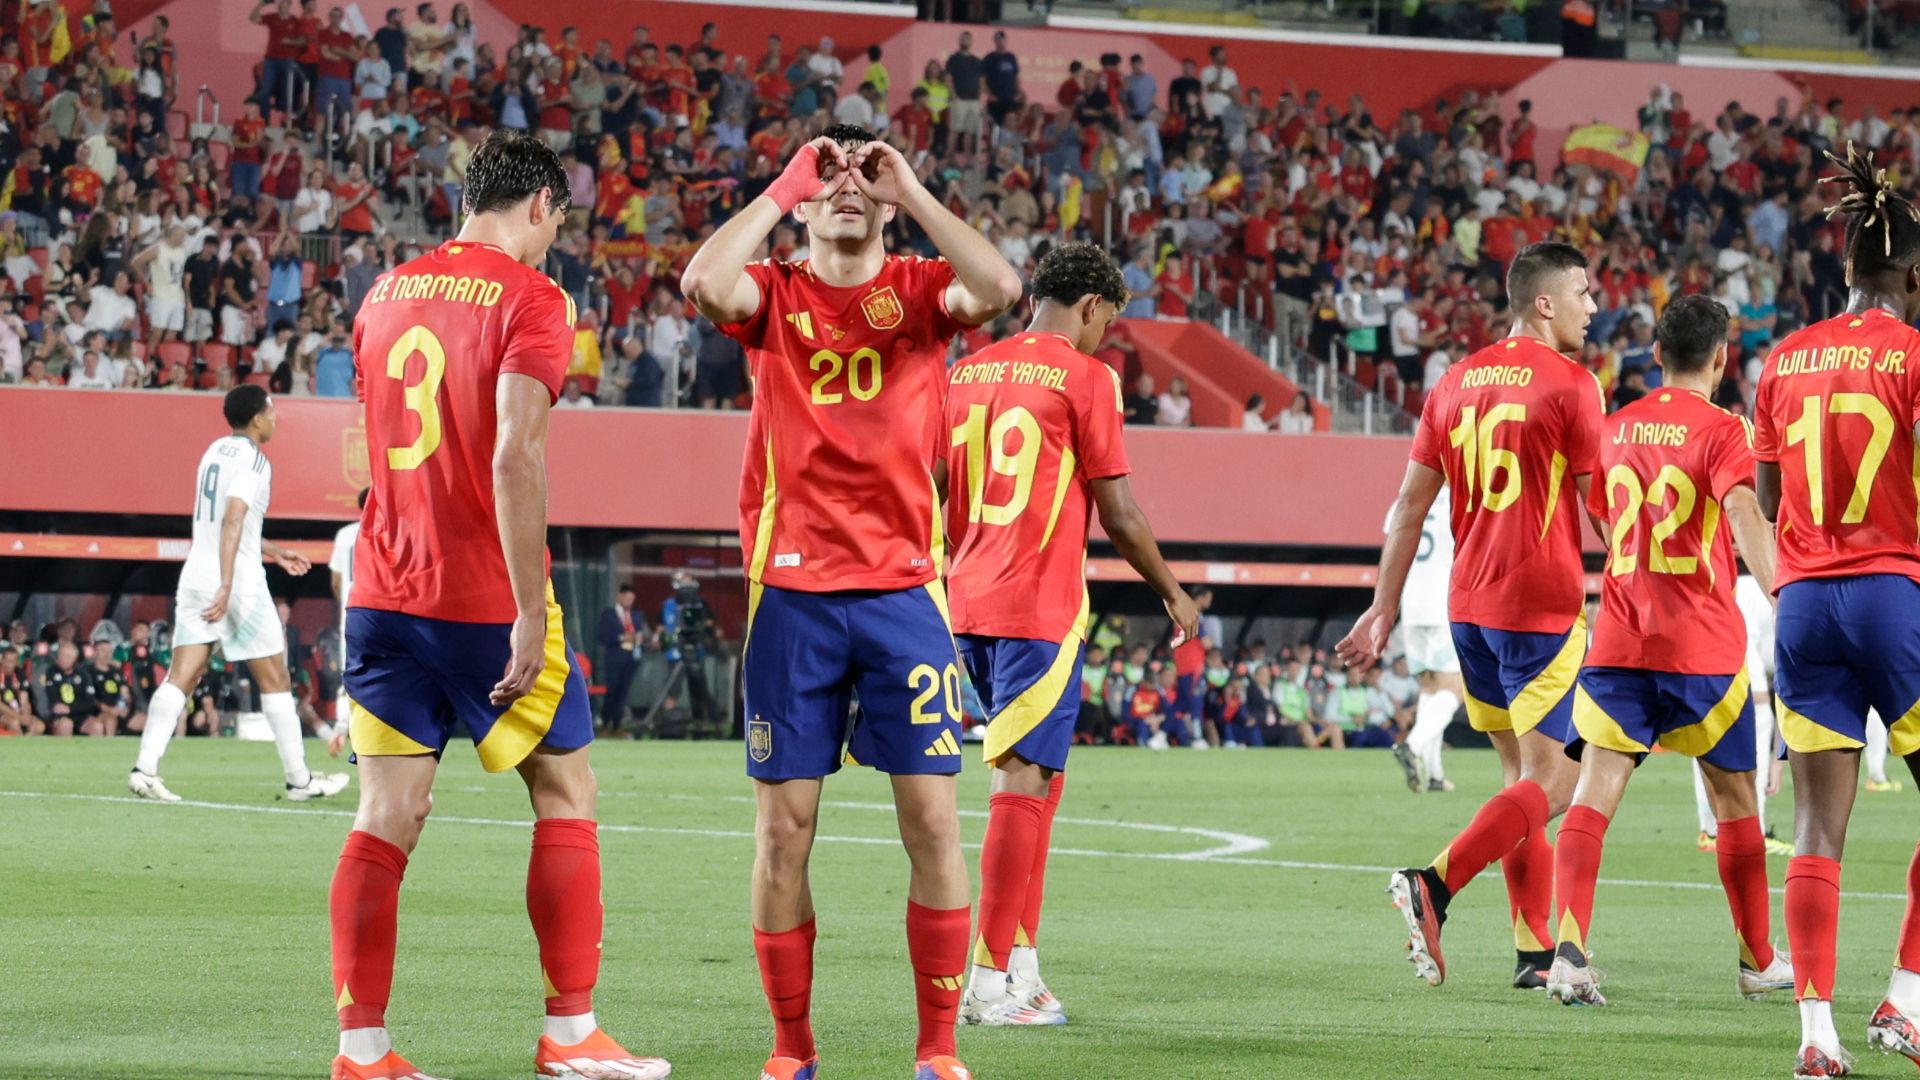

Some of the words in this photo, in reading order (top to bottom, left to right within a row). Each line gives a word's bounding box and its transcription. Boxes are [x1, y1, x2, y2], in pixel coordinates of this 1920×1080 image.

[372, 277, 393, 304] LE
[393, 274, 503, 306] NORMAND
[810, 347, 882, 404] 20
[950, 362, 1009, 384] LAMINE
[1011, 361, 1068, 391] YAMAL
[1461, 365, 1533, 389] RODRIGO
[1777, 345, 1872, 376] WILLIAMS
[1874, 348, 1906, 374] JR.
[386, 325, 446, 470] 3
[1449, 402, 1526, 512] 16
[1613, 422, 1627, 445] J.
[1631, 421, 1687, 446] NAVAS
[1786, 392, 1895, 526] 17
[196, 463, 220, 522] 19
[951, 403, 1042, 526] 19
[1606, 464, 1697, 577] 22
[908, 662, 962, 725] 20
